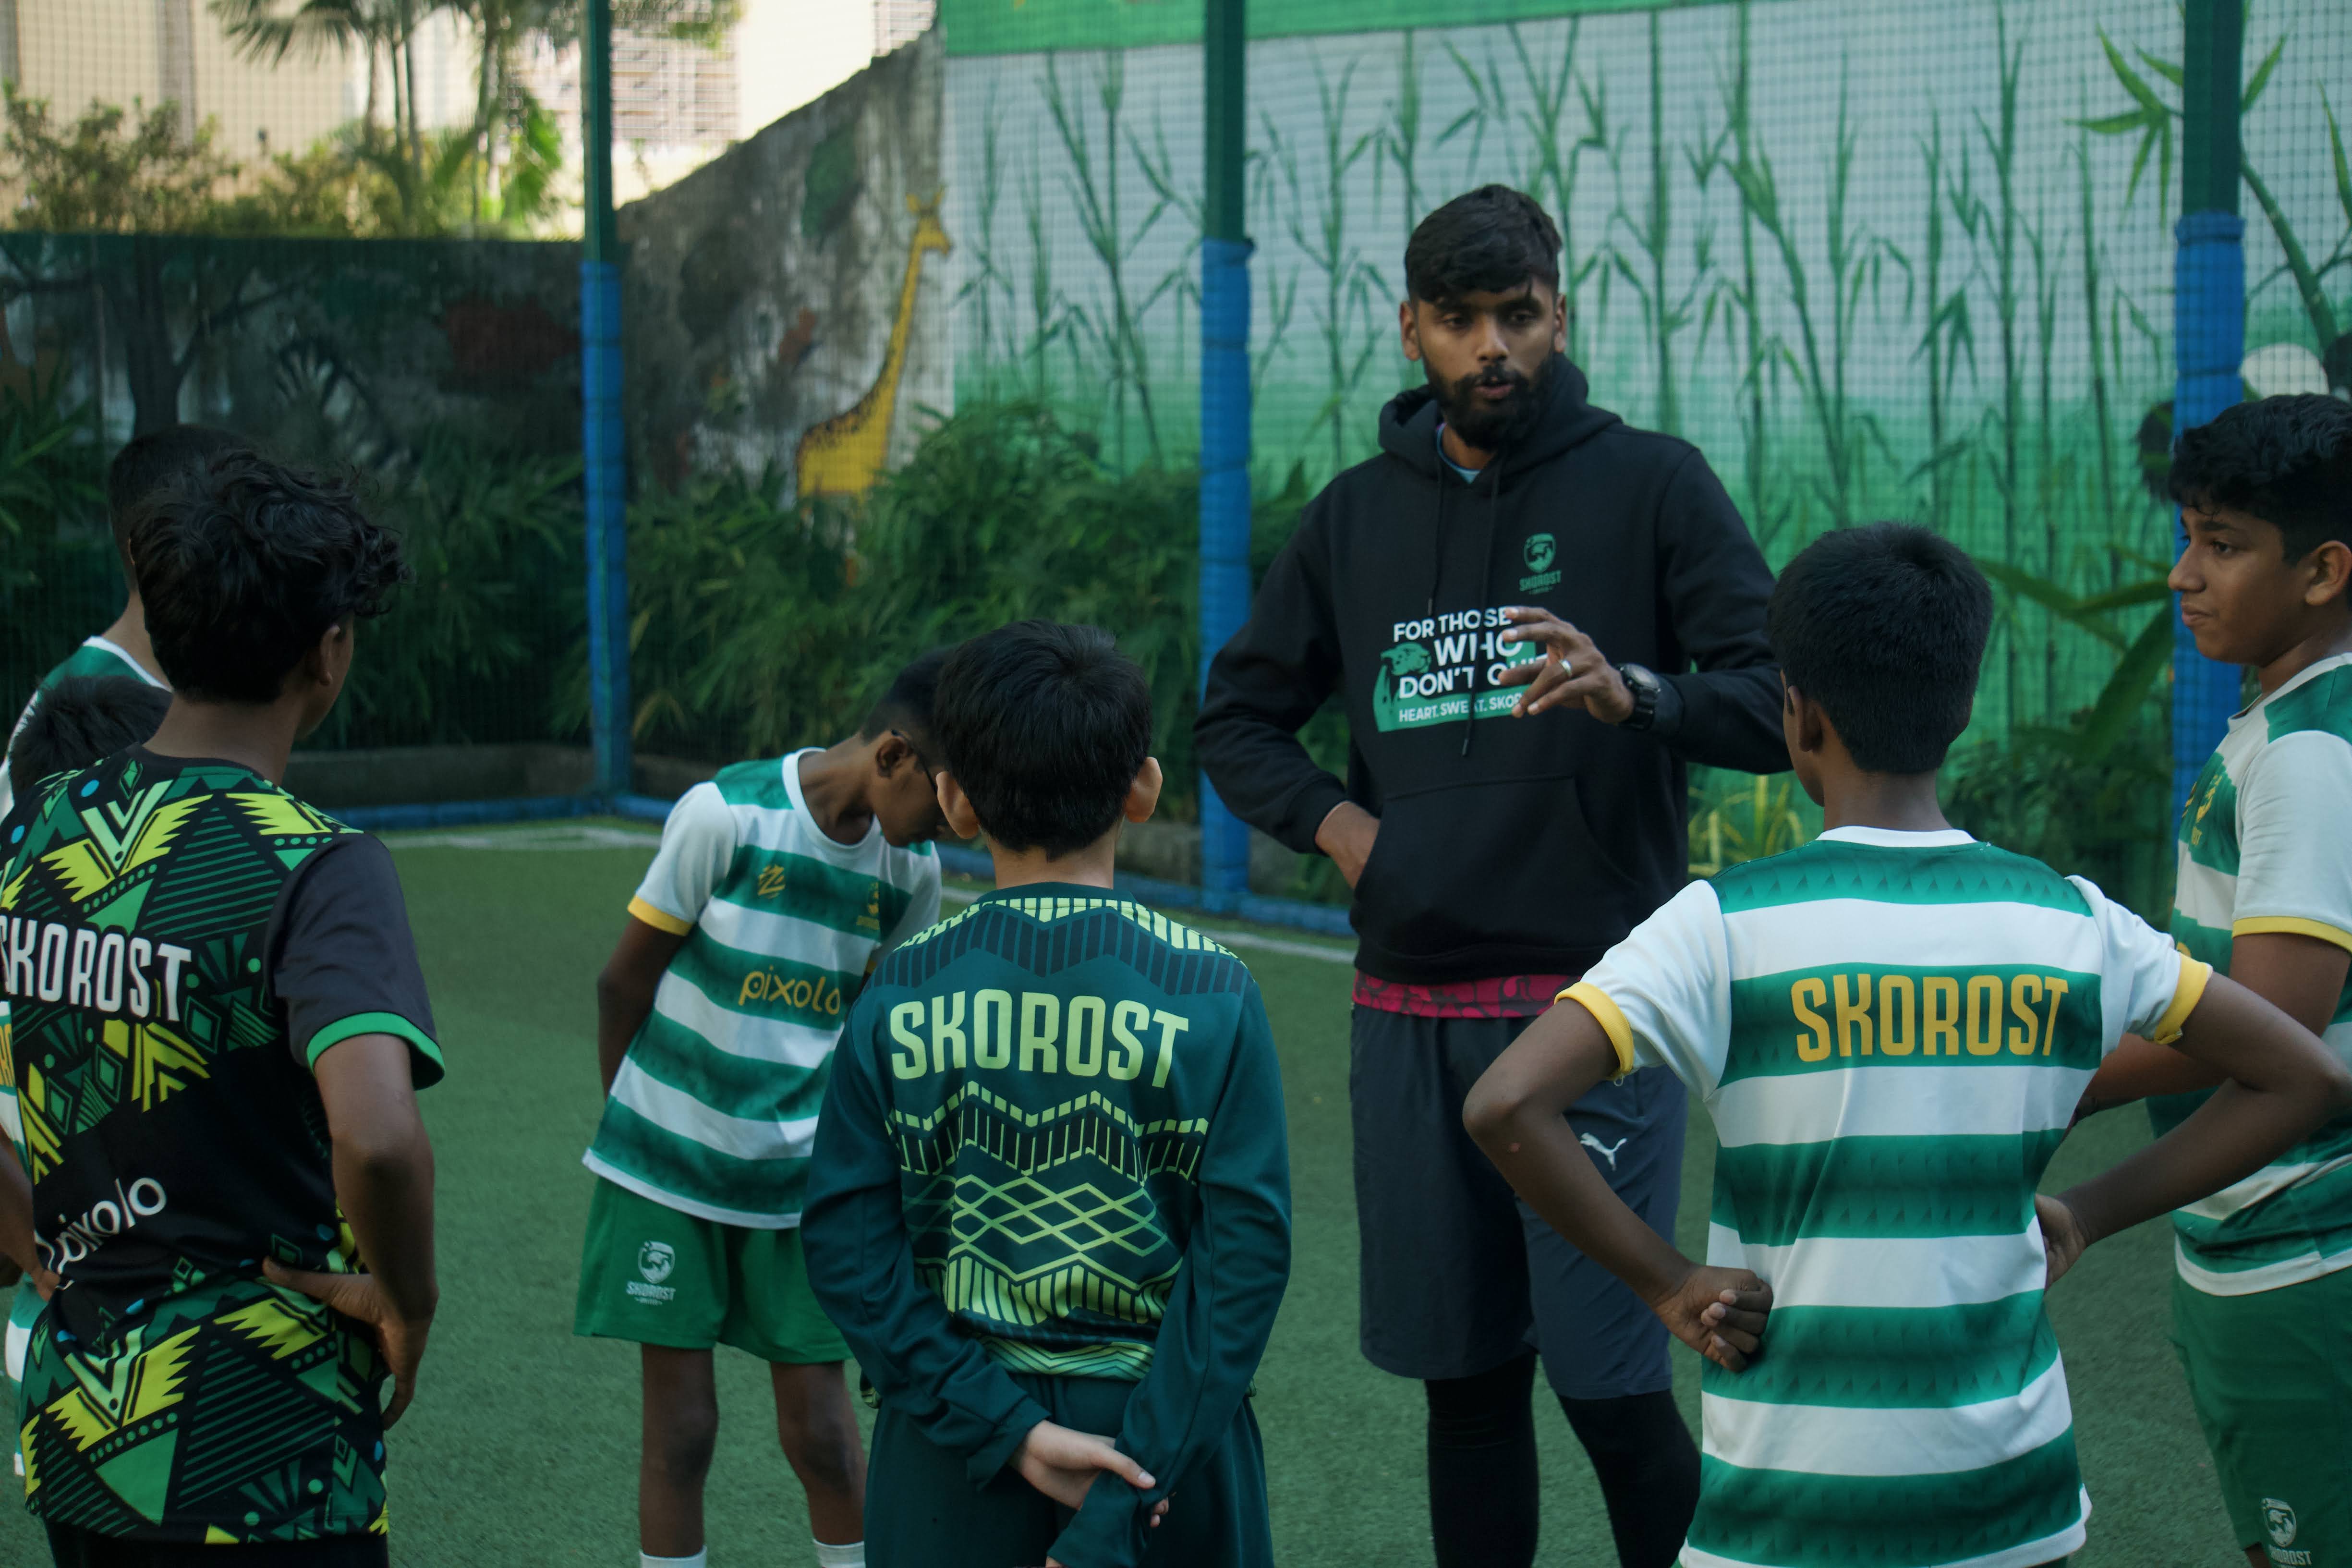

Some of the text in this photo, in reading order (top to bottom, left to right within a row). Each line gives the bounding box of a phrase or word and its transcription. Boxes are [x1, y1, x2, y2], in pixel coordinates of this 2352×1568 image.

[1394, 607, 1512, 643] FOR THOSE
[1433, 631, 1523, 666] WHO
[1399, 666, 1475, 699] DON'T
[738, 965, 840, 1015] pixolo
[890, 988, 1188, 1088] SKOROST
[1791, 973, 2069, 1062] SKOROST
